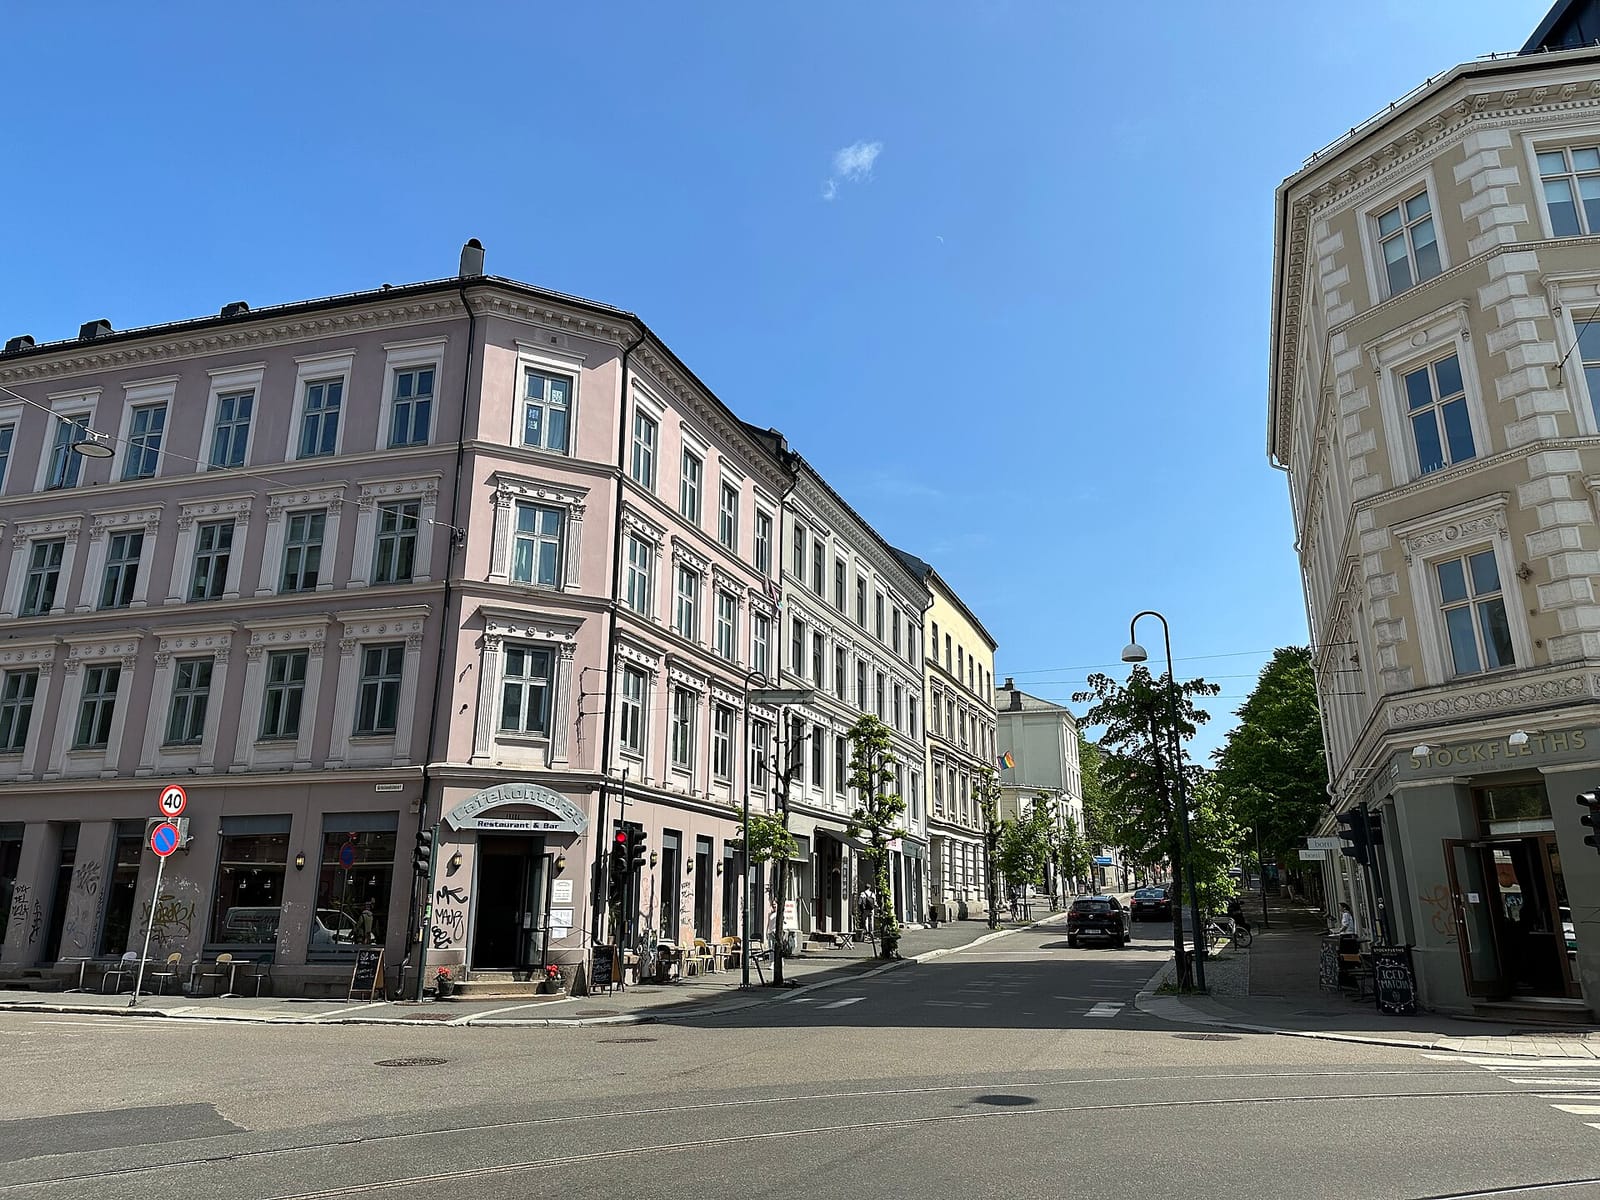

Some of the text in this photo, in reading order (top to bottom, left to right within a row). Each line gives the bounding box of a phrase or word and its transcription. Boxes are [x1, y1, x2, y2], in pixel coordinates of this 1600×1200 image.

[1409, 730, 1587, 770] STOCKFLETHS
[164, 793, 182, 809] 40
[477, 820, 530, 829] Restaurant
[543, 822, 560, 830] Bar
